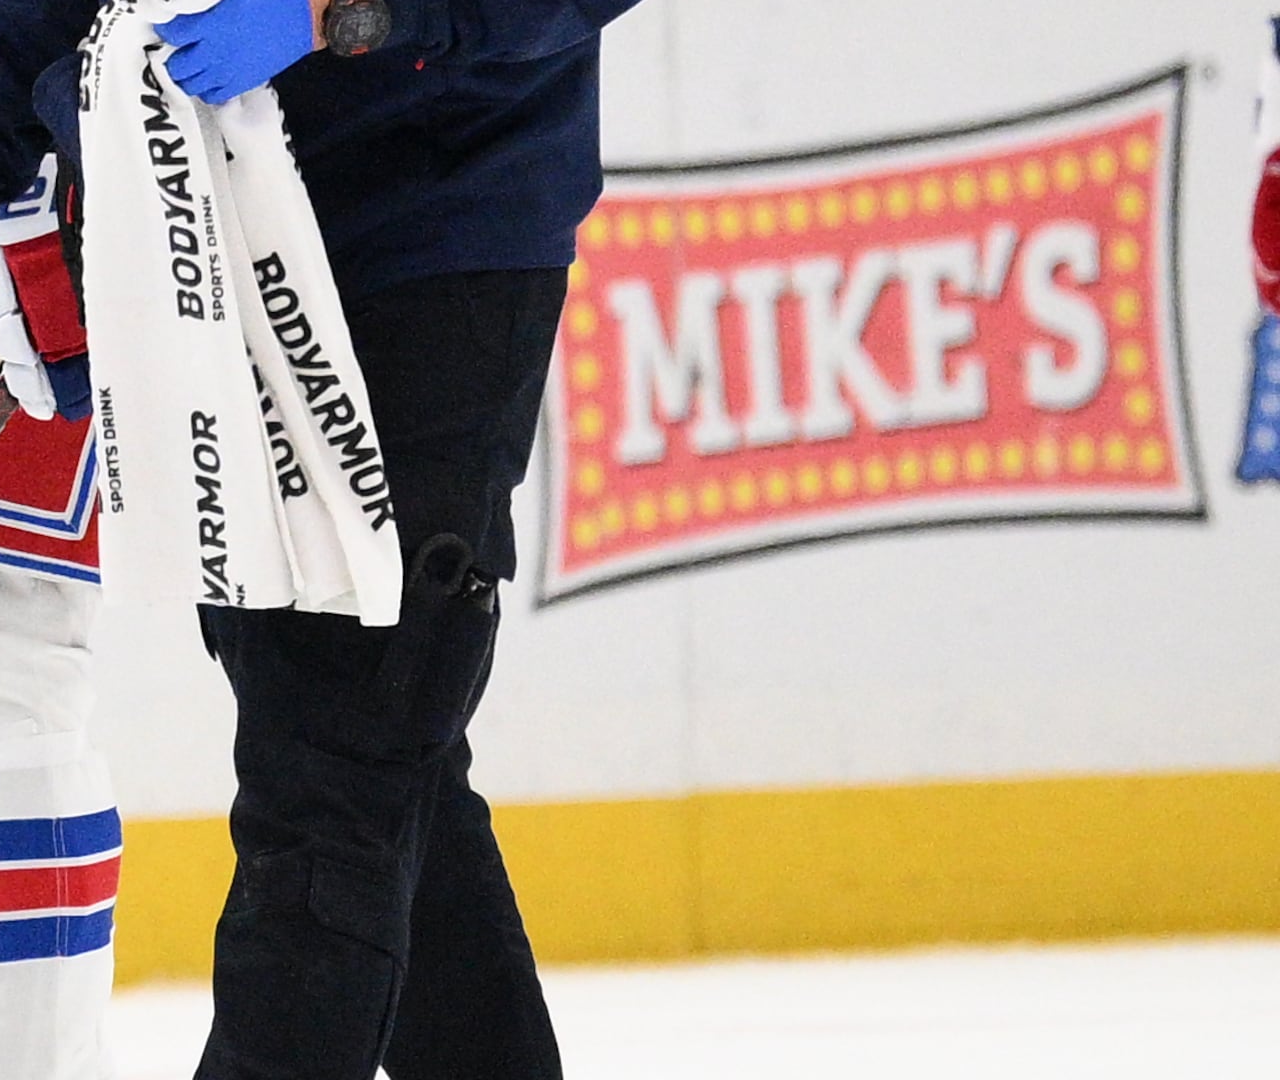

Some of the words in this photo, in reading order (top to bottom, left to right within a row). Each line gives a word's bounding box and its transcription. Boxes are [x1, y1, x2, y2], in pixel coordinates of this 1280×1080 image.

[203, 195, 218, 247] DRINK
[212, 253, 226, 322] SPORTS
[609, 221, 1109, 467] MIKE'S
[99, 386, 117, 441] DRINK
[251, 251, 395, 533] BODYARMOR
[105, 444, 125, 514] SPORTS
